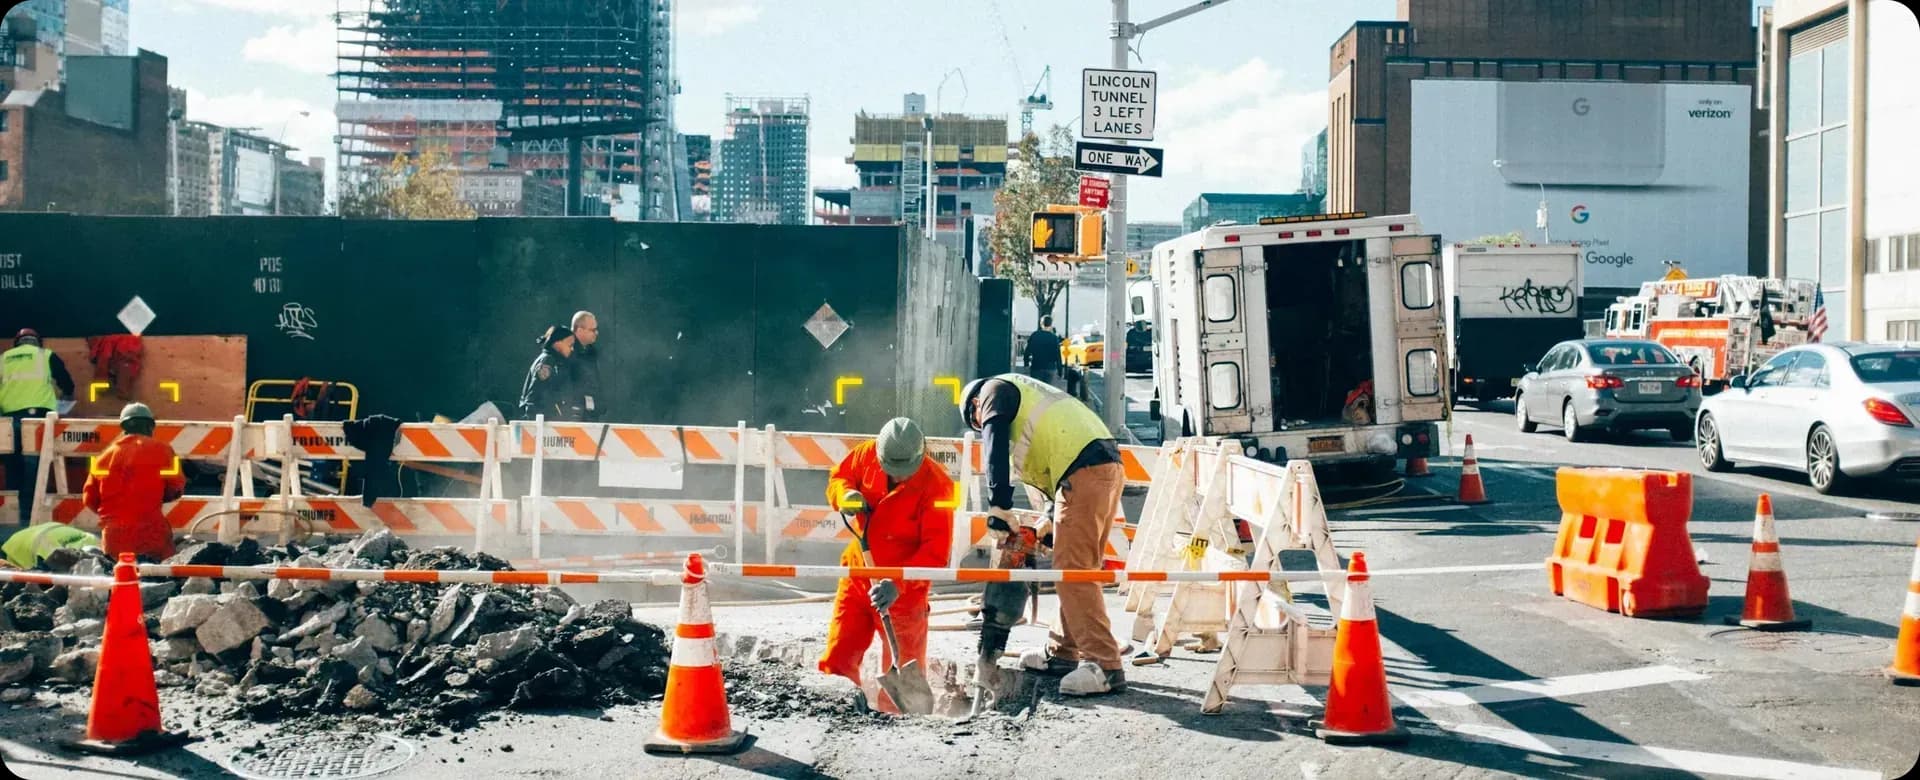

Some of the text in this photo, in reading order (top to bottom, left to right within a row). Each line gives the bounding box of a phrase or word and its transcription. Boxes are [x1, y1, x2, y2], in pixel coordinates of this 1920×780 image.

[1089, 75, 1150, 89] LINCOLN
[1091, 90, 1148, 104] TUNNEL
[1093, 105, 1144, 118] 3 LEFT
[1572, 97, 1590, 116] G
[1688, 107, 1731, 118] verizon
[1094, 121, 1142, 134] LANES
[1088, 151, 1150, 167] ONE WAY
[1571, 204, 1589, 224] G
[1586, 251, 1633, 268] Google
[1, 273, 33, 289] BILLS
[62, 431, 100, 443] TRIUMPH
